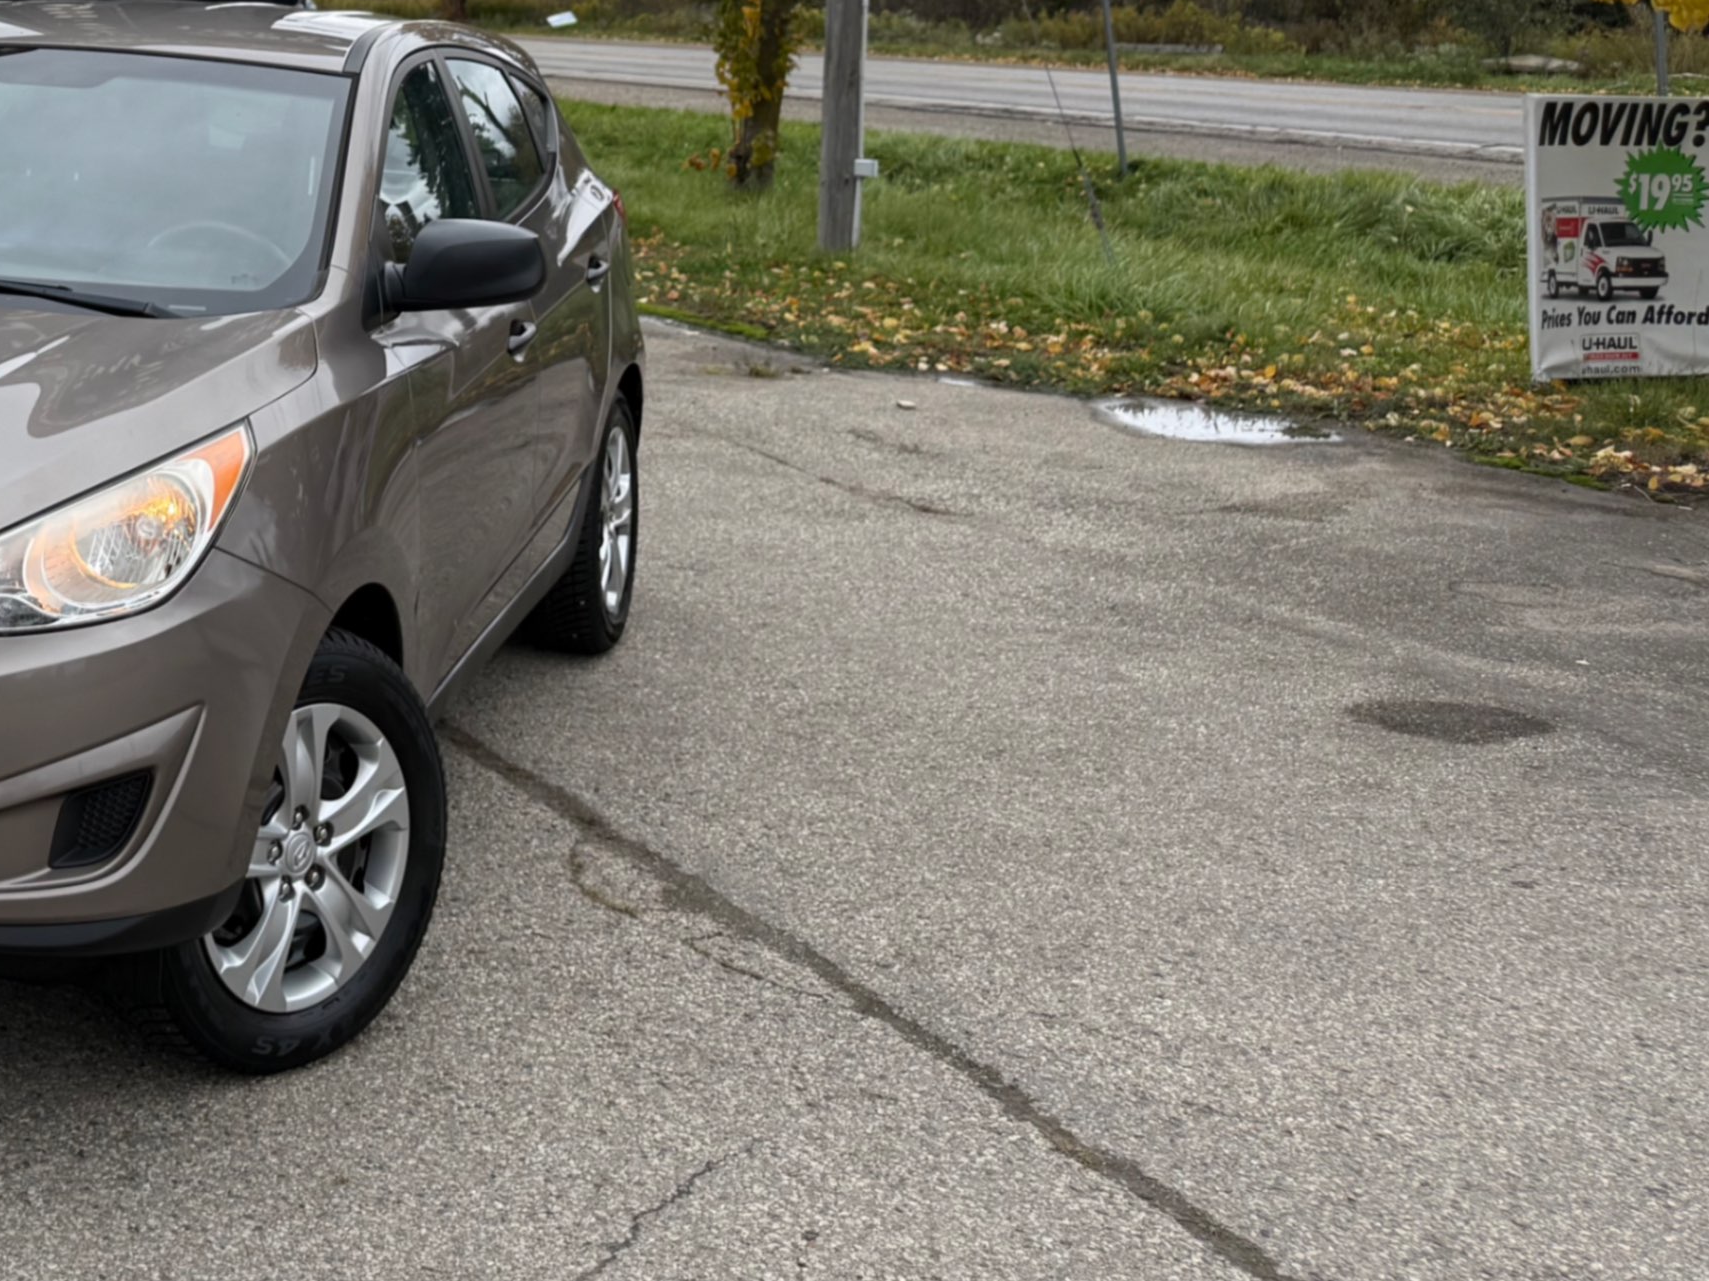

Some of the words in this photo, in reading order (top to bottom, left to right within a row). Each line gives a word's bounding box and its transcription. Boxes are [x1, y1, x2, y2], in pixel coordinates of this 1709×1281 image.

[1538, 101, 1709, 147] MOVING?
[1541, 306, 1573, 330] Prices
[1577, 305, 1602, 327] You
[1606, 305, 1637, 326] Can
[1642, 304, 1709, 326] Afford
[1582, 336, 1638, 351] U-HAUL
